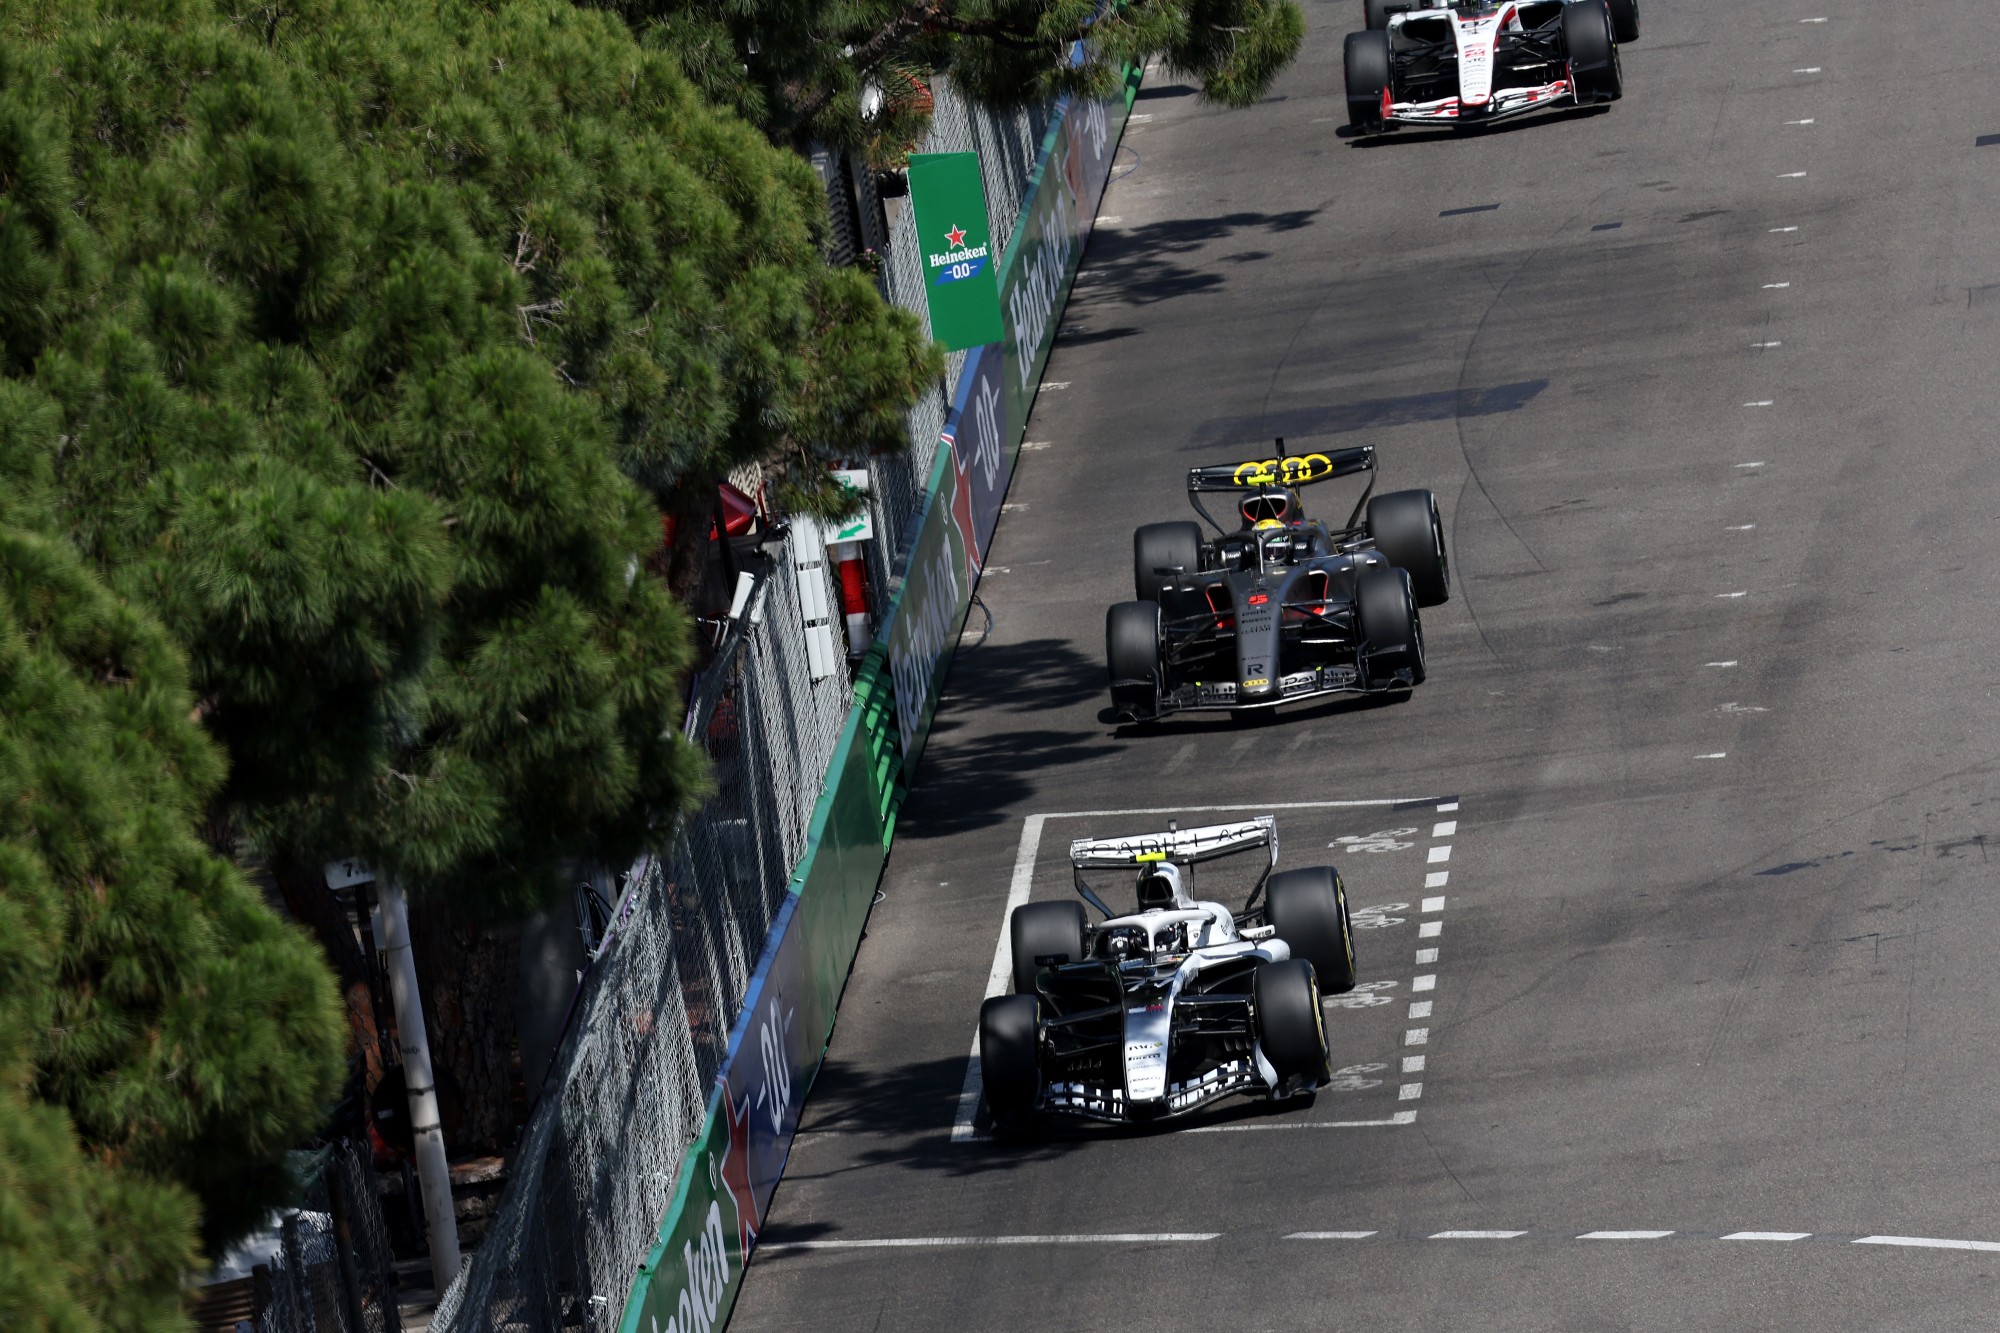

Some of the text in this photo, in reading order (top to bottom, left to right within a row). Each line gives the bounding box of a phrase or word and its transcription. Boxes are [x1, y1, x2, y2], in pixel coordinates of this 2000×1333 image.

[929, 246, 988, 268] Heineken
[1009, 189, 1071, 391] Heineken
[1248, 594, 1269, 605] 5
[1247, 663, 1264, 676] R
